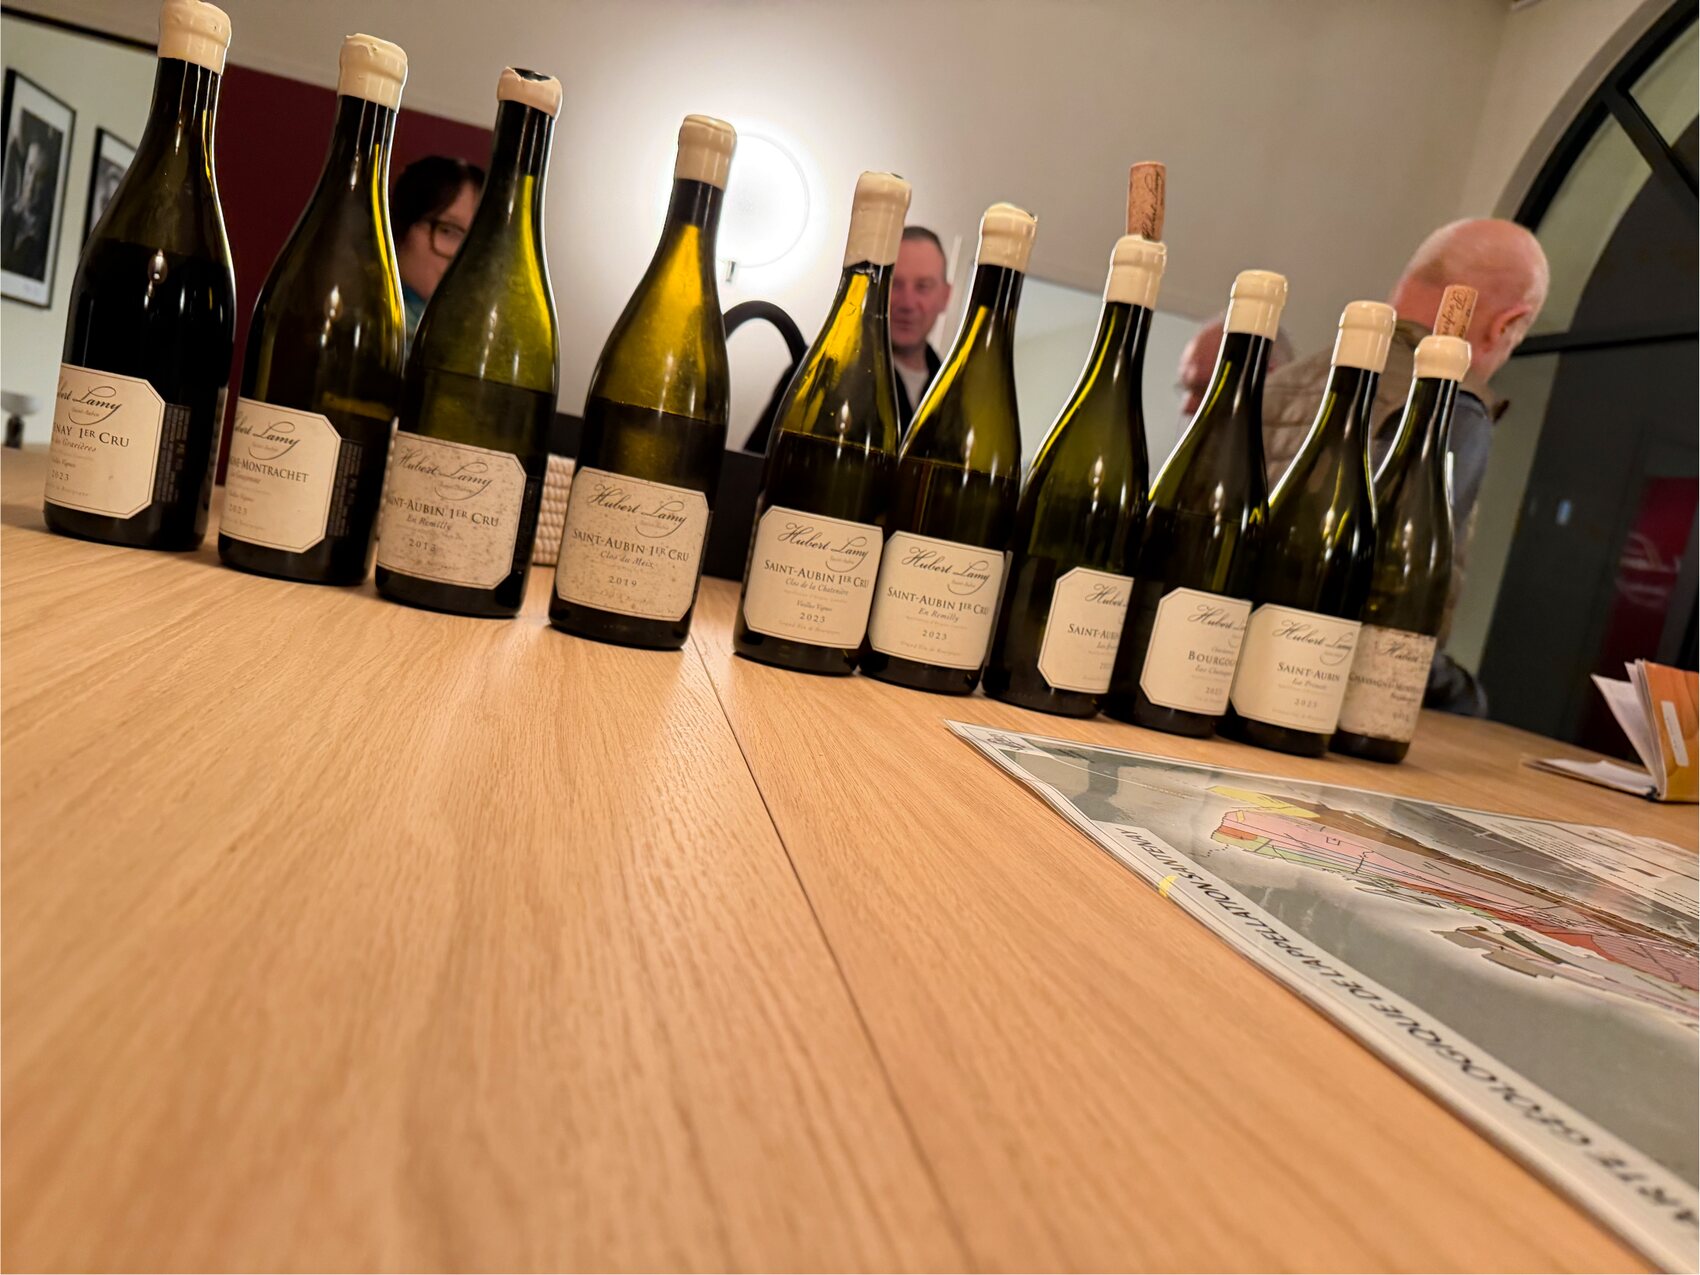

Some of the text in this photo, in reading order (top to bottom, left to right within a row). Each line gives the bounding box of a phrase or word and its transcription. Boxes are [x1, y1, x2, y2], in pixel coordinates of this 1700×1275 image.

[67, 385, 122, 426] Lamy
[79, 427, 96, 439] 1ER
[98, 431, 130, 448] CRU
[248, 420, 302, 461] Lamy
[399, 448, 494, 502] Hubert Lamy
[449, 508, 468, 520] 1ER
[471, 512, 500, 528] CRU
[587, 483, 688, 539] Hubert Lamy
[572, 529, 690, 563] SAINT-AUBIN 1ER CRU
[600, 550, 618, 561] Clos
[777, 522, 870, 574] Hubert Lamy
[763, 559, 836, 583] SAINT-AUBIN
[853, 576, 870, 589] CRU
[785, 576, 800, 587] Clos
[901, 546, 991, 596] Hubert Lamy
[886, 586, 956, 611] SAINT-AUBIN
[799, 612, 826, 624] 2023
[1187, 604, 1234, 630] Hubert
[922, 629, 948, 641] 2023
[1272, 619, 1326, 647] Hubert
[1276, 661, 1341, 682] SAINT-AUBIN
[1114, 827, 1204, 881] SANTENAY
[1330, 979, 1382, 1001] DE
